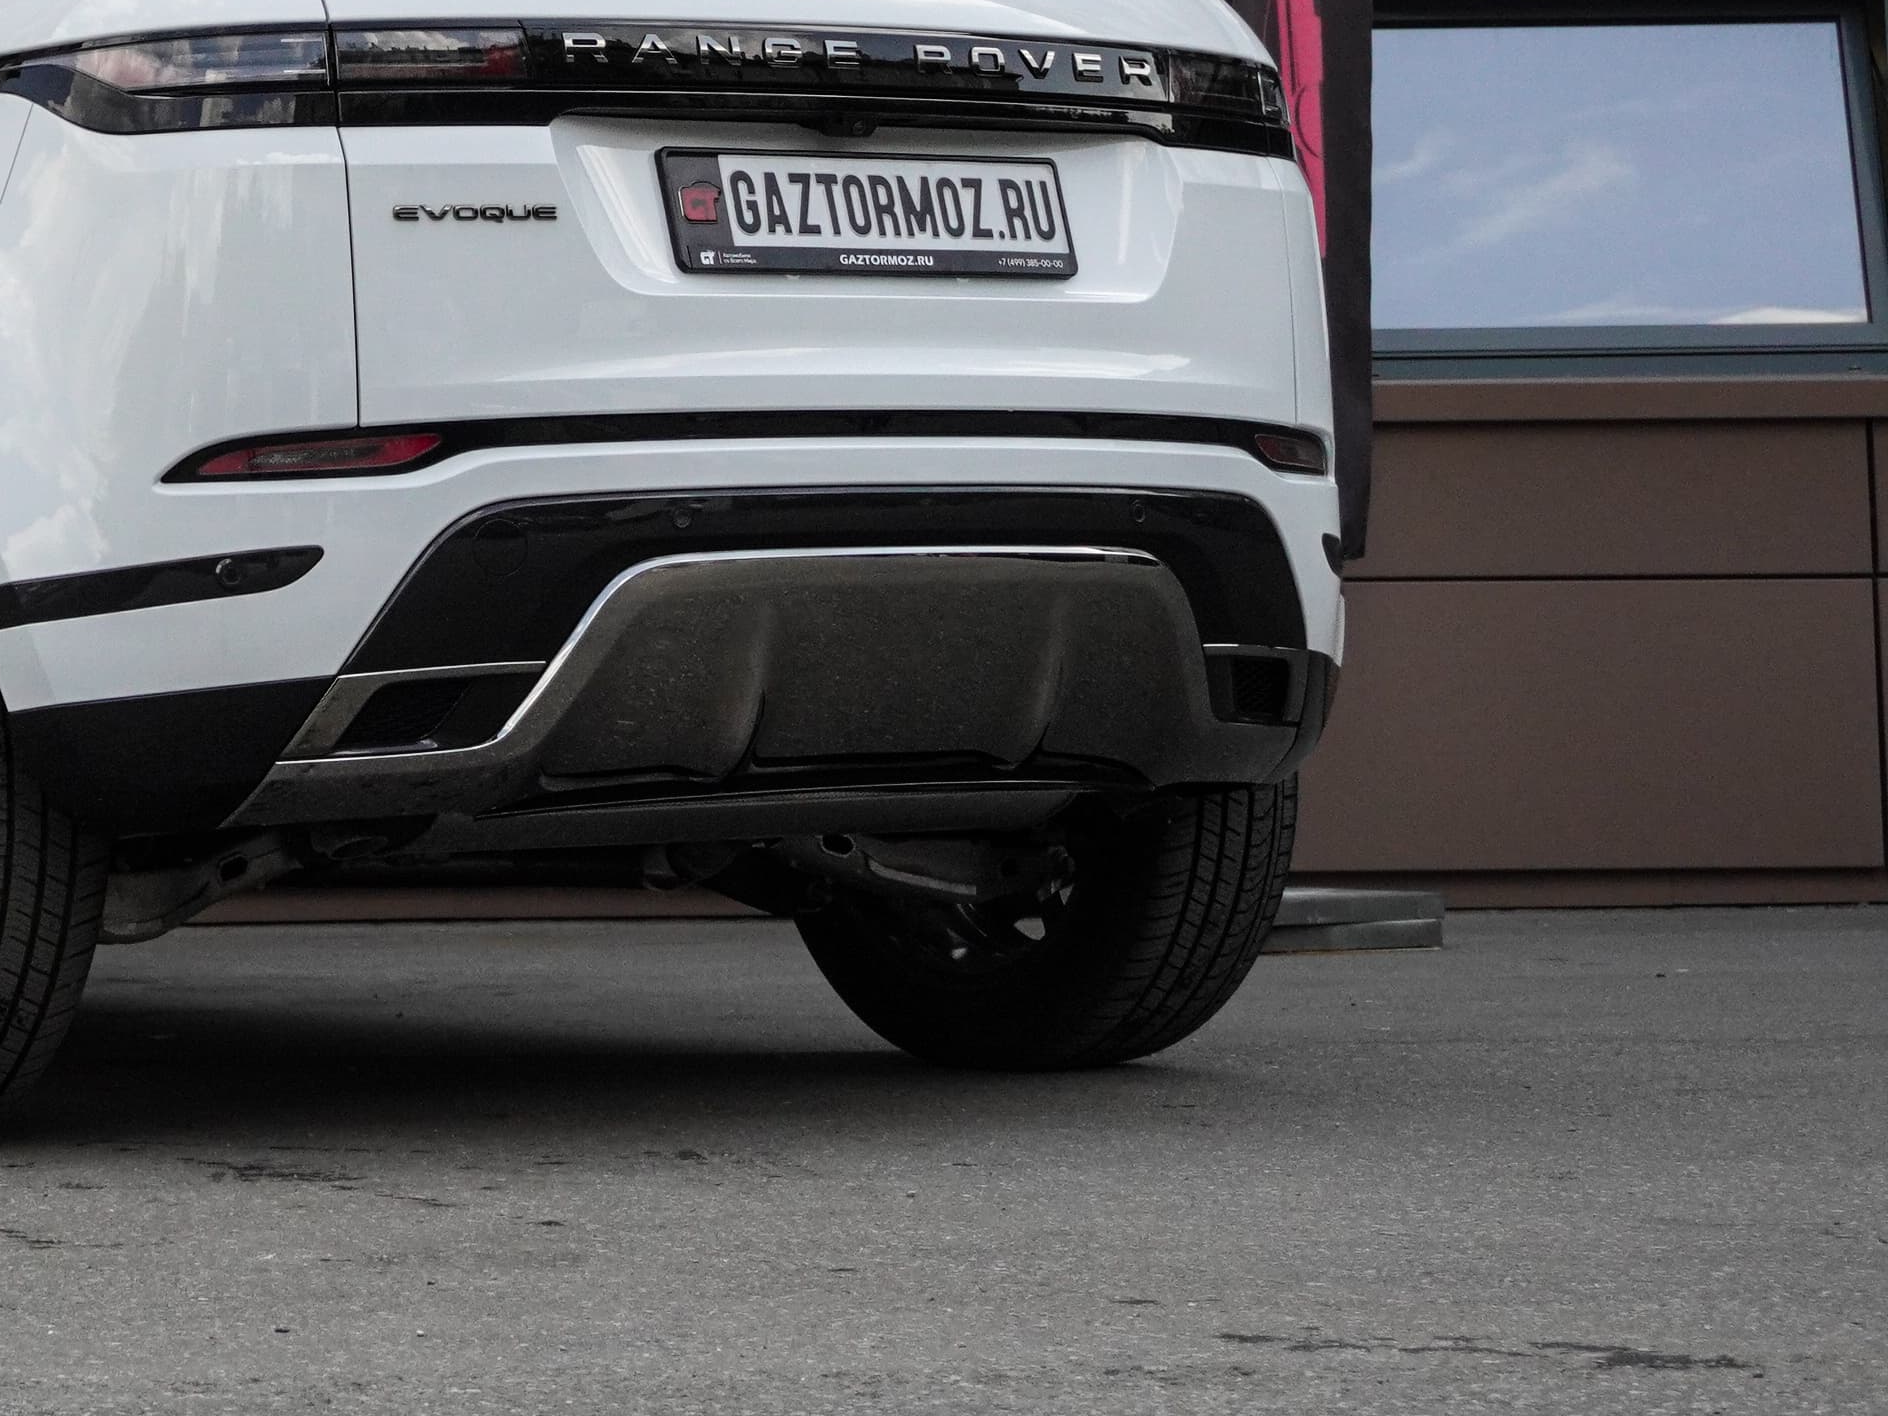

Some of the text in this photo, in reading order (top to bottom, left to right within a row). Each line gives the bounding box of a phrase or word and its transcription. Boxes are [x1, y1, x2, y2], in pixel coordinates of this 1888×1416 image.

[561, 31, 1156, 86] RANGE ROVER
[392, 204, 558, 224] EVOQUE
[729, 170, 1057, 241] GAZTORMOZ.RU
[839, 254, 934, 267] GAZTORMOZ.RU
